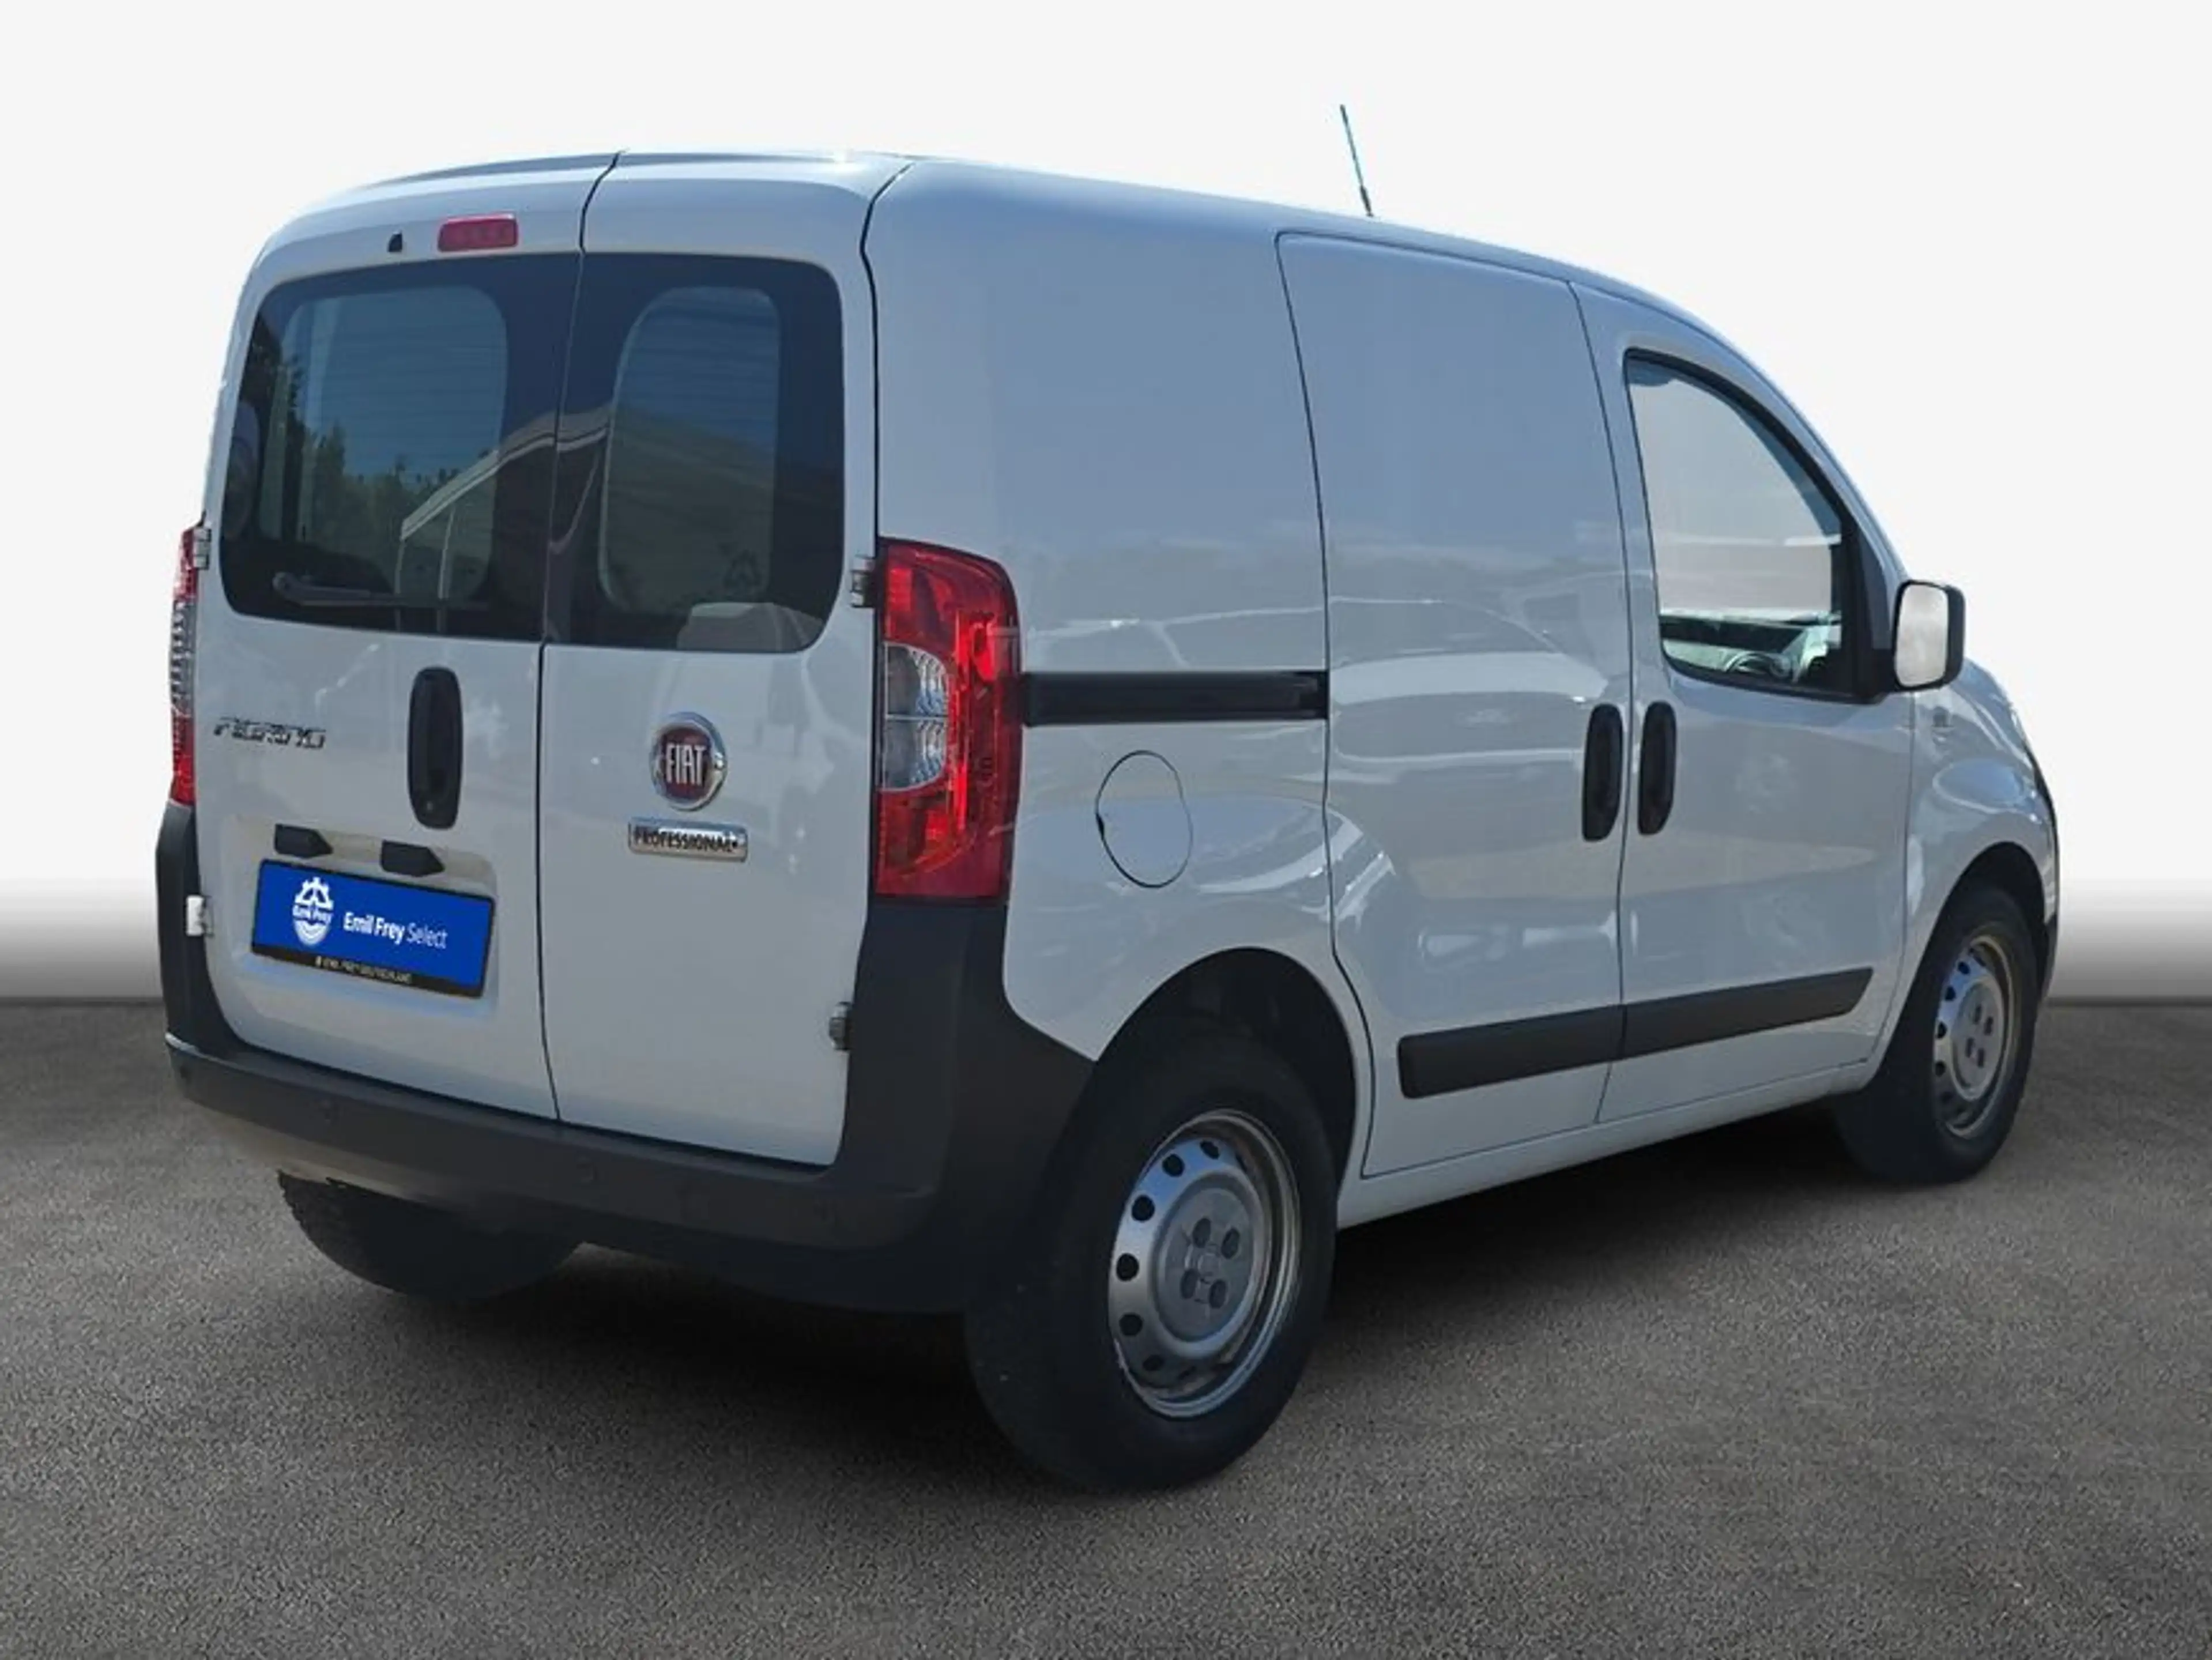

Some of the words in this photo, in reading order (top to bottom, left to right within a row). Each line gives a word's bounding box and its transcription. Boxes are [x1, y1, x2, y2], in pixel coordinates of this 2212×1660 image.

[665, 742, 707, 786] FIAT
[635, 826, 734, 853] PROFESSIONAL
[344, 911, 374, 934] Emil
[375, 916, 405, 945] Frey
[406, 922, 448, 949] Select
